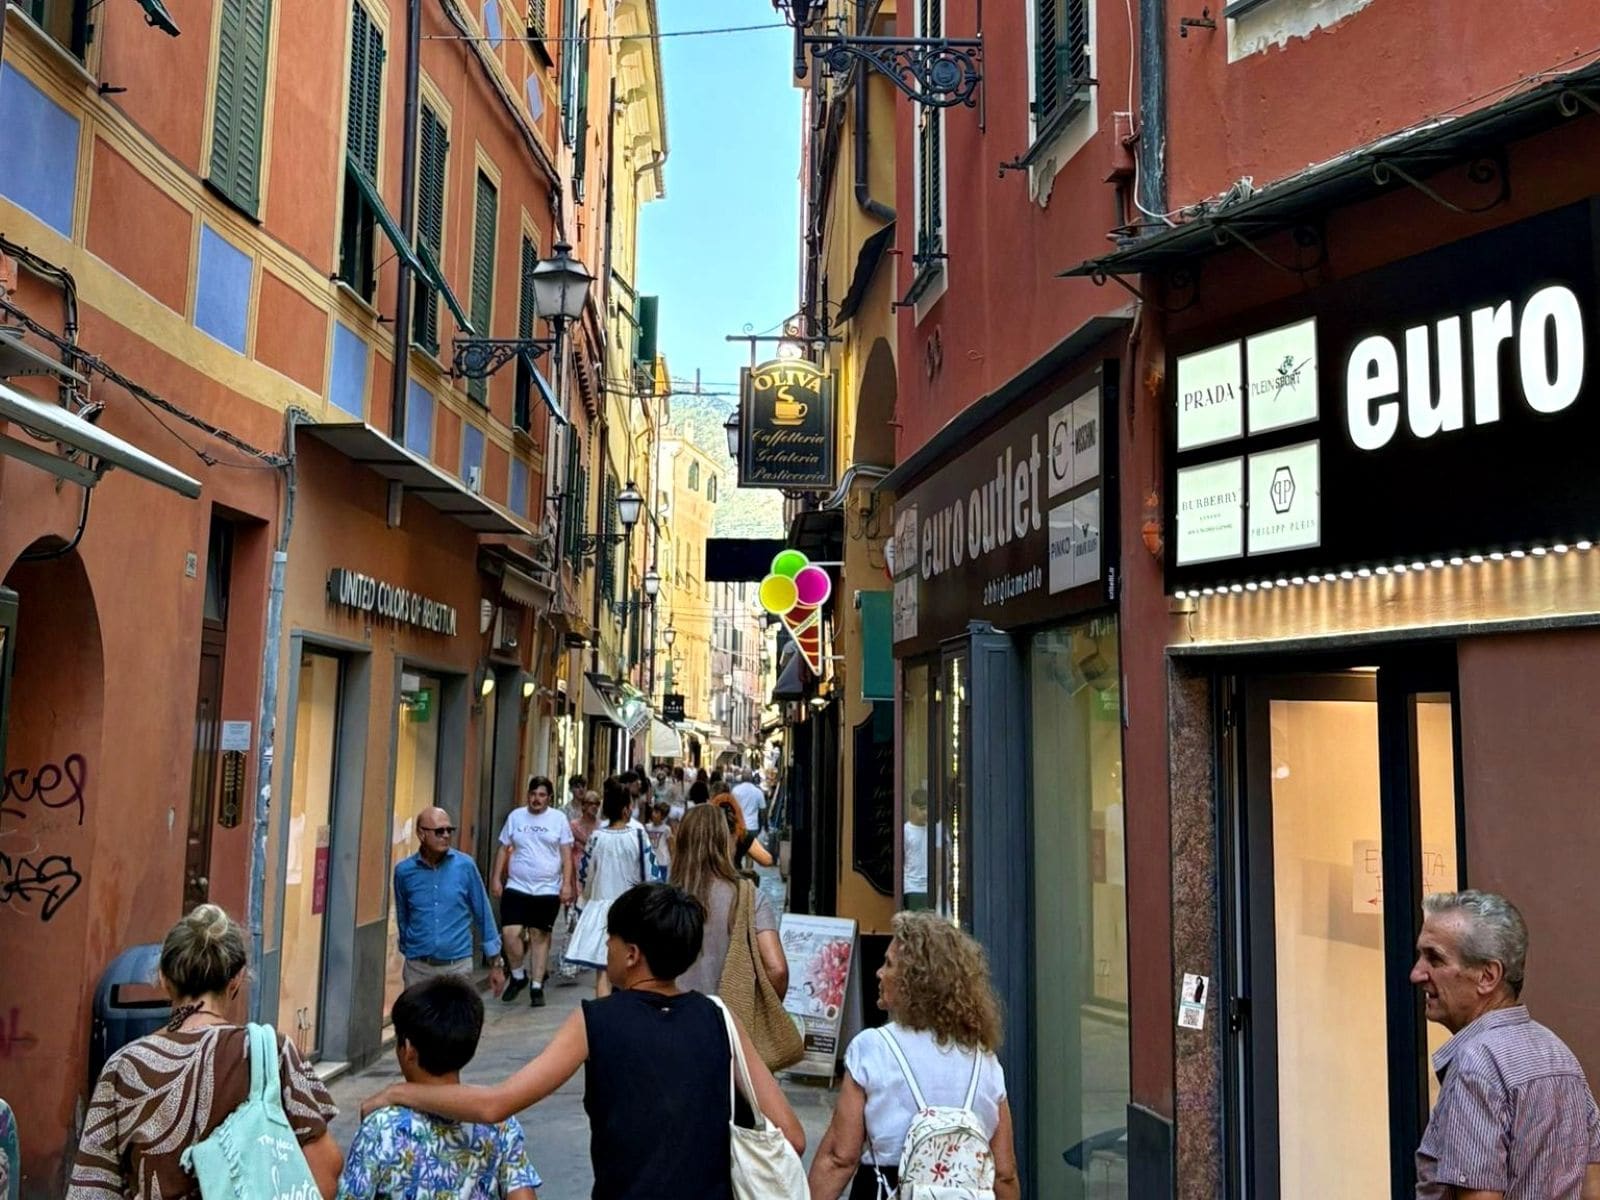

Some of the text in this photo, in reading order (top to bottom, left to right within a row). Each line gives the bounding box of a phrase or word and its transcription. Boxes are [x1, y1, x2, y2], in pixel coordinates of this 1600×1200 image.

[1347, 285, 1585, 451] euro
[754, 370, 821, 394] OLIVA
[1184, 382, 1235, 412] PRADA
[752, 429, 824, 447] Caffetteria
[757, 448, 819, 463] Gelateria
[752, 467, 826, 481] Pasticceria
[921, 433, 1041, 581] euro outlet
[1182, 491, 1238, 511] BURBERRY
[340, 568, 376, 611] UNITED
[377, 581, 410, 622] COLORS
[410, 592, 422, 626] OF
[983, 565, 1043, 607] abbigliamento
